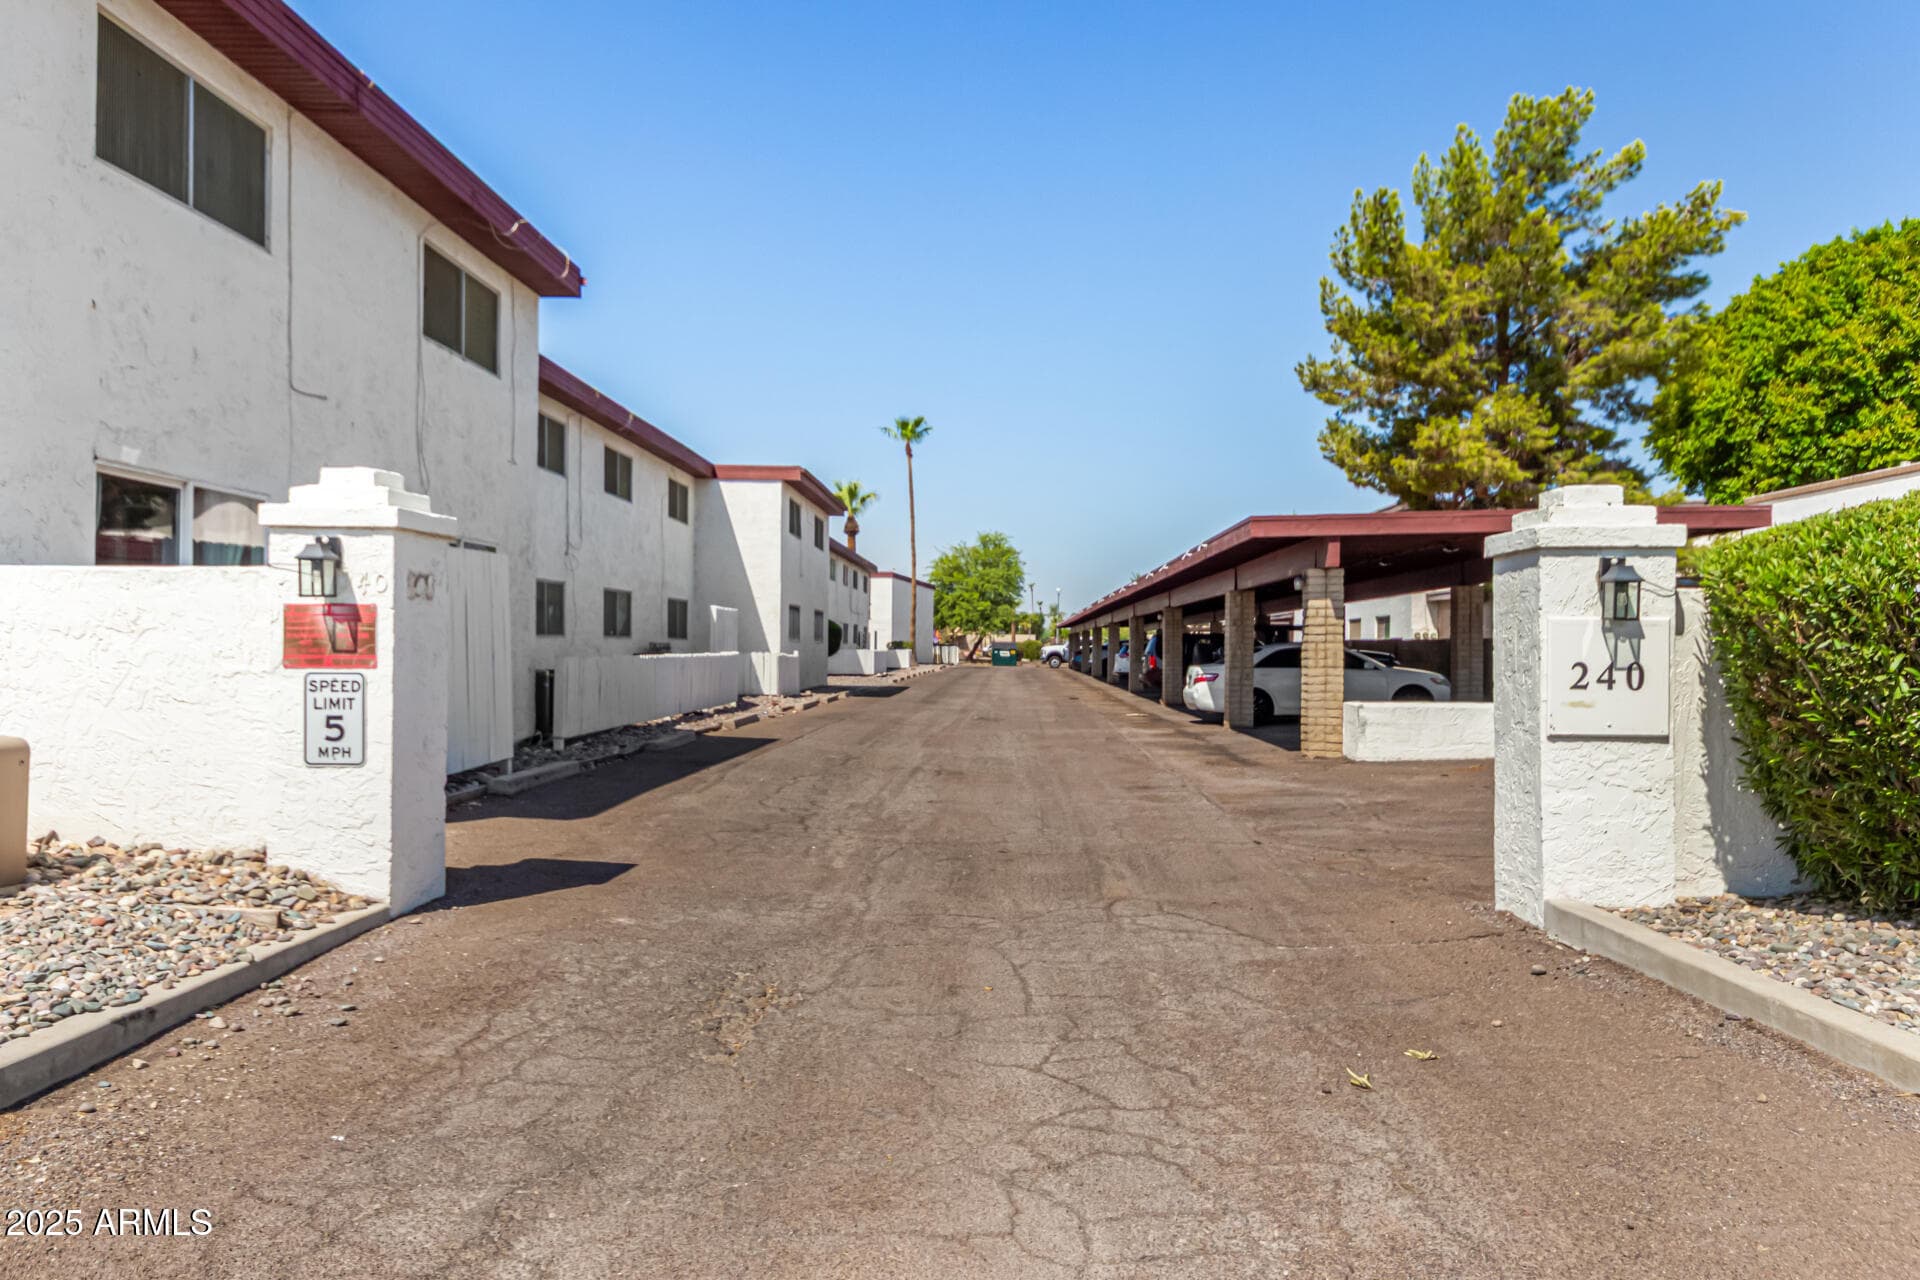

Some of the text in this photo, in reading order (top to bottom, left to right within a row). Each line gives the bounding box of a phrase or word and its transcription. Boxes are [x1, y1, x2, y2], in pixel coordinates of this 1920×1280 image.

[1569, 661, 1645, 691] 240
[309, 680, 361, 692] SPEED
[313, 698, 355, 710] LIMIT
[325, 715, 345, 742] 5
[318, 747, 352, 758] MPH
